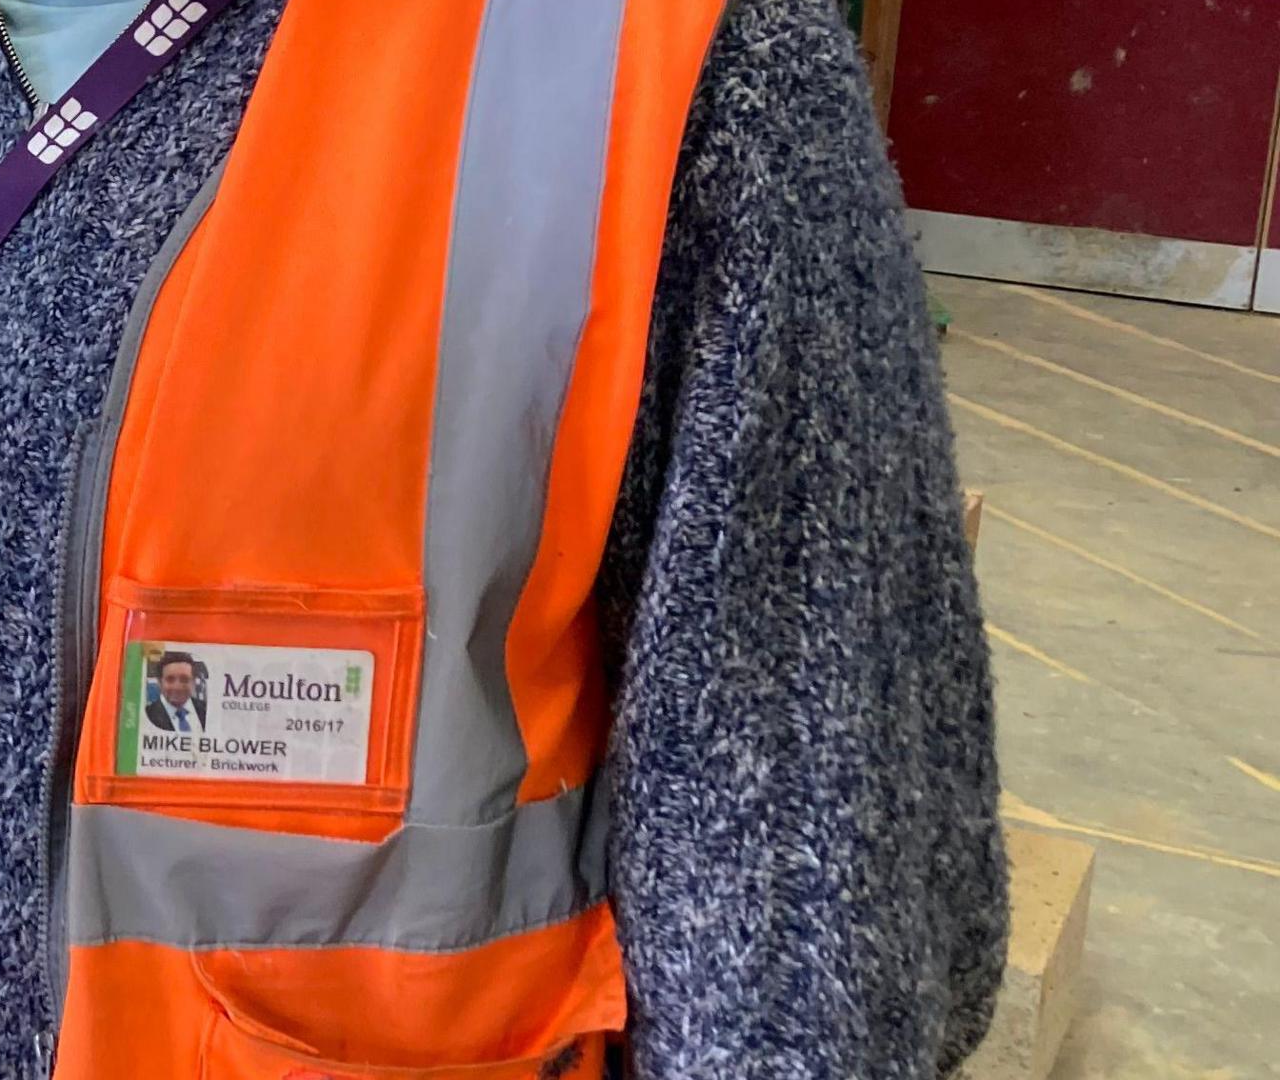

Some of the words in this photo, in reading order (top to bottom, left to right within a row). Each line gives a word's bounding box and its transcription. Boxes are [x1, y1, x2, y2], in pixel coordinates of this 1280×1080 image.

[223, 673, 342, 702] Moulton
[222, 701, 271, 712] COLLEGE
[286, 718, 344, 733] 2016/17
[143, 735, 192, 752] MIKE
[199, 738, 287, 756] BLOWER
[141, 756, 197, 769] Lecturer
[211, 758, 279, 773] Brickwork
